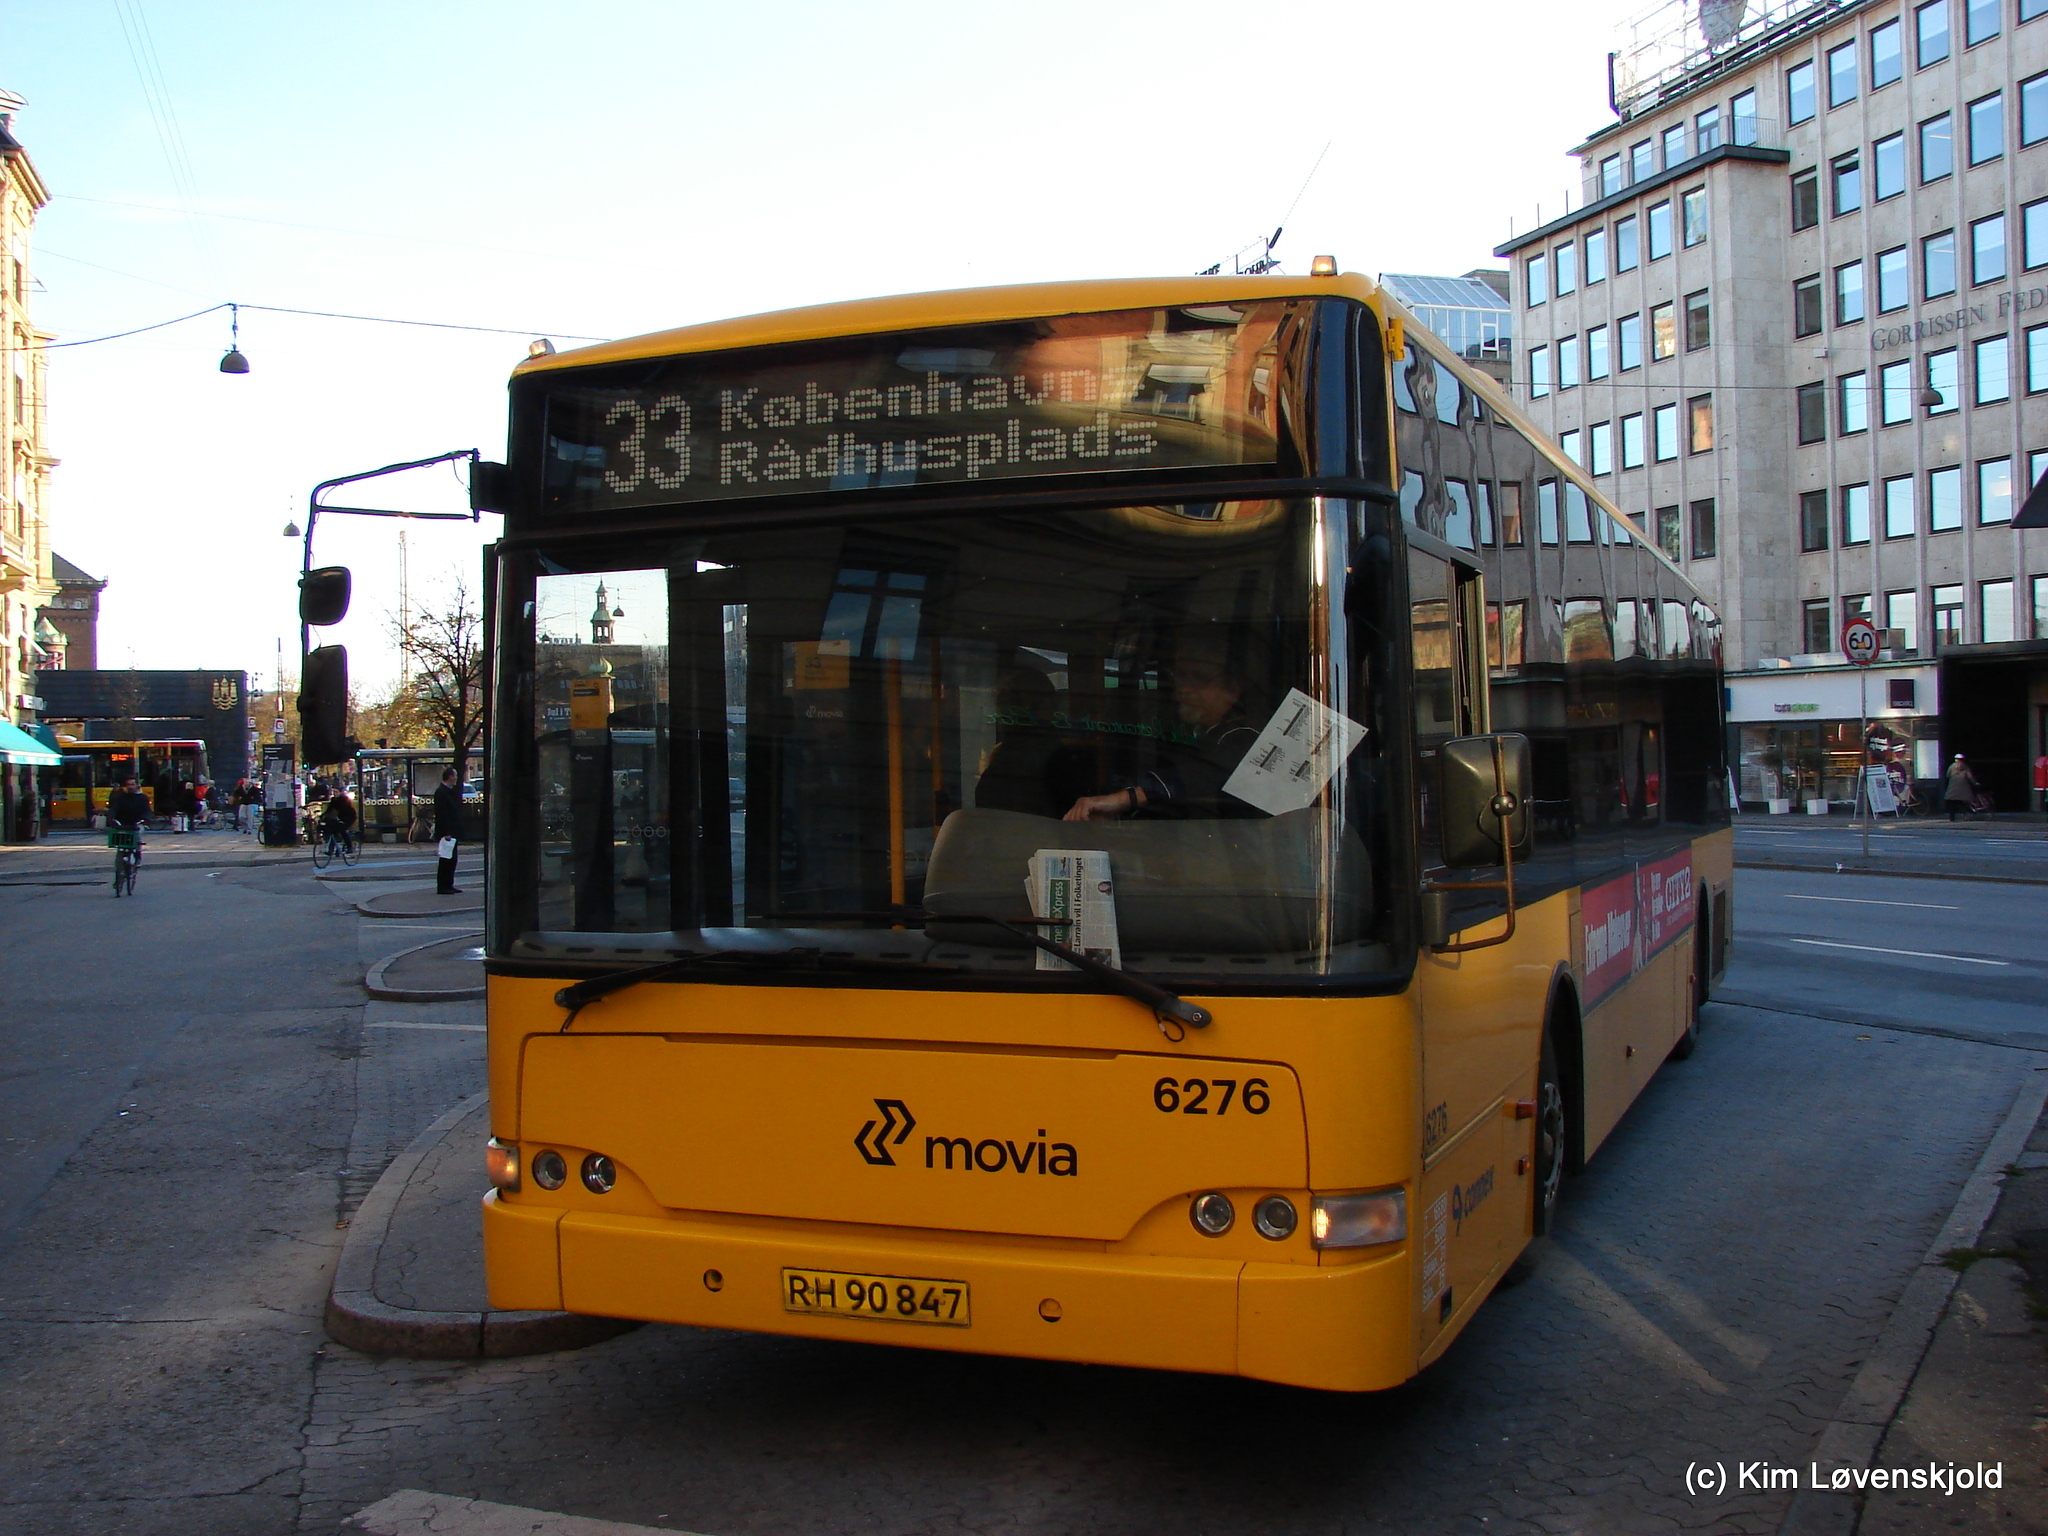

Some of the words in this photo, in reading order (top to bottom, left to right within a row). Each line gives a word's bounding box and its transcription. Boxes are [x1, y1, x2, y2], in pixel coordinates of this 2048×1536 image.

[1872, 303, 1987, 351] GORRISSEN
[604, 394, 692, 494] 33
[720, 411, 1159, 485] Rådhusplads
[1849, 632, 1873, 650] 60
[1153, 1077, 1271, 1116] 6276
[925, 1128, 1078, 1176] movia
[789, 1275, 836, 1308] RH
[846, 1280, 888, 1313] 90
[896, 1285, 962, 1319] 847
